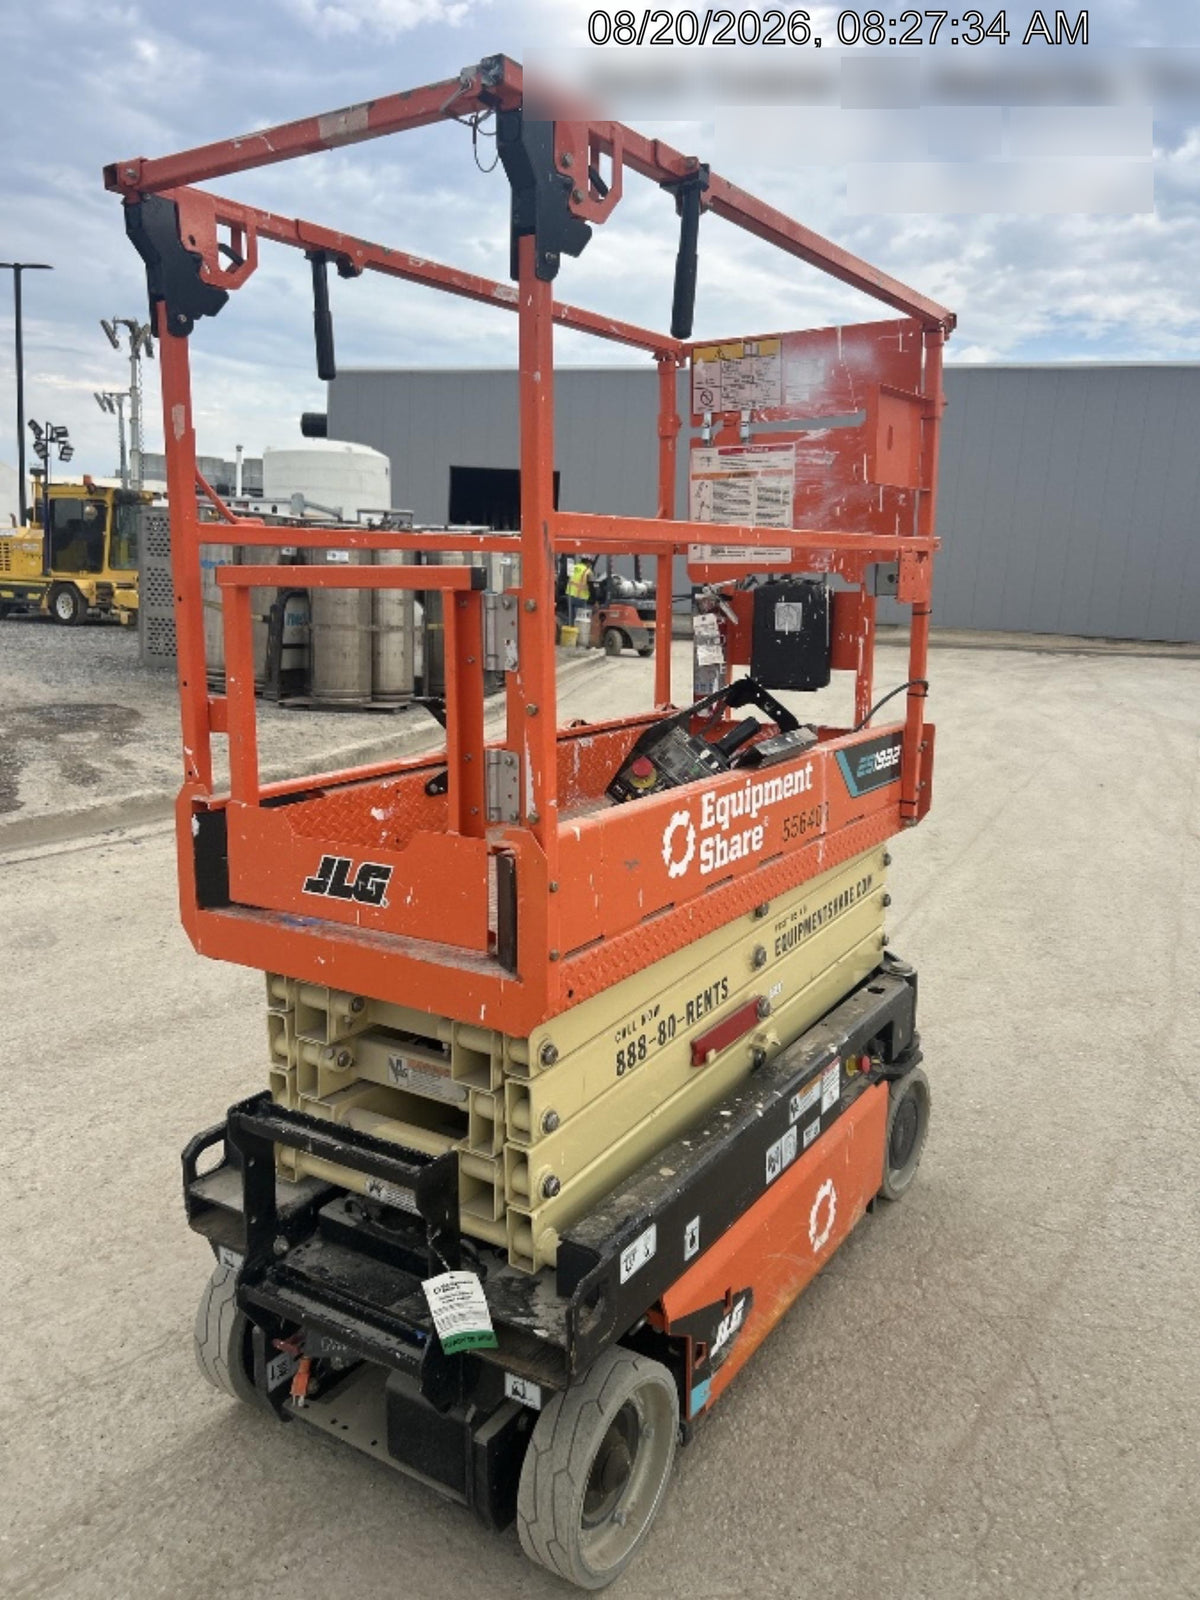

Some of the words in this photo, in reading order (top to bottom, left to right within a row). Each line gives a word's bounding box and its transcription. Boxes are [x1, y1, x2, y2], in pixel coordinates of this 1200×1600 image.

[700, 762, 813, 831] Equipment
[301, 854, 394, 907] JLG
[699, 825, 764, 875] Share
[615, 975, 729, 1077] 888-80-RENTS
